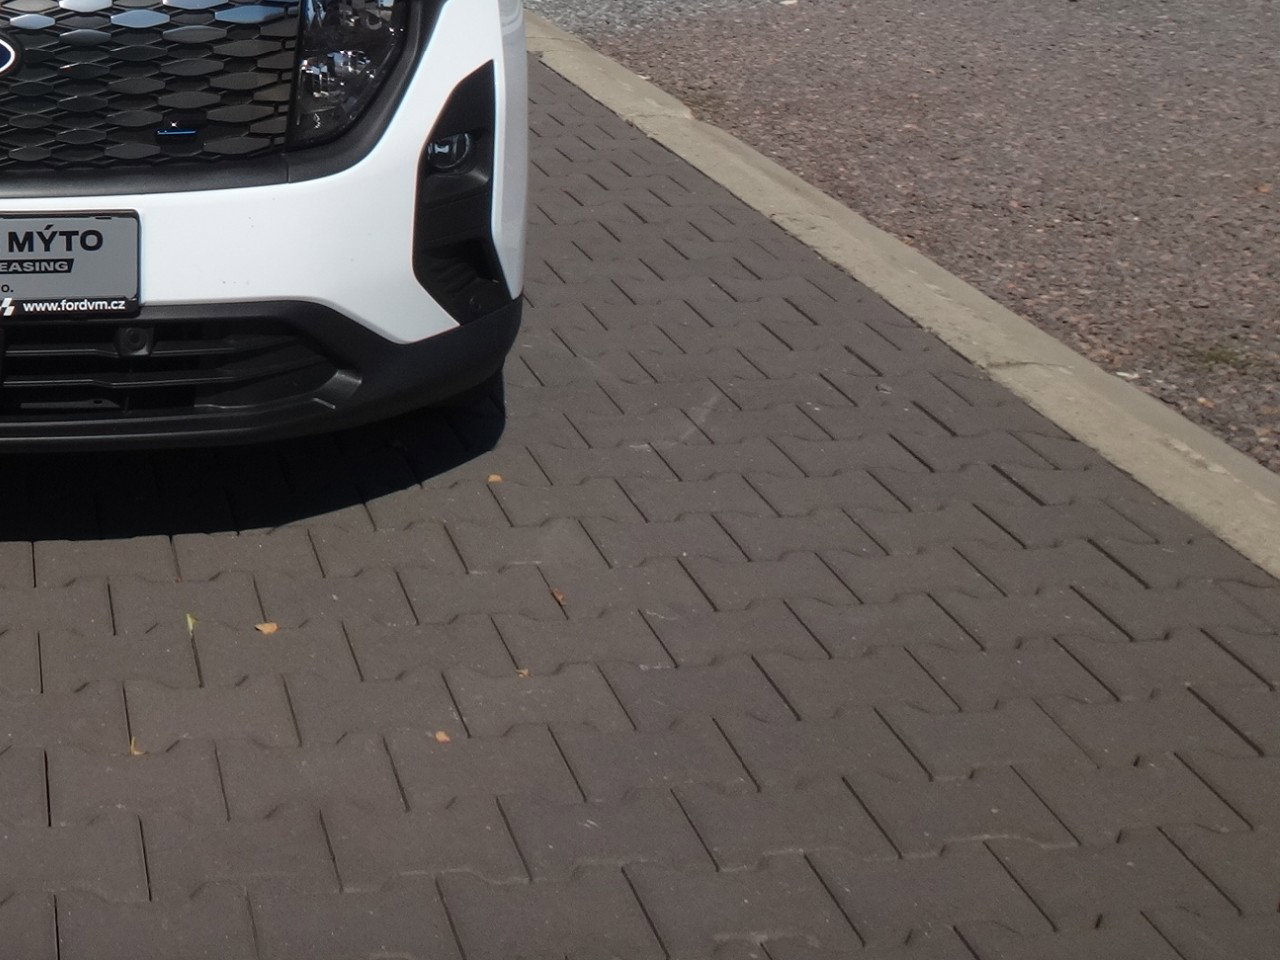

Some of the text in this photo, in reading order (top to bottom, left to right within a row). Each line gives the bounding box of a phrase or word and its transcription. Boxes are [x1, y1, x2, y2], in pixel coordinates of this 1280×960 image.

[8, 224, 104, 253] MÝTO
[1, 284, 14, 293] o.
[23, 299, 126, 312] www.fordvm.cz
